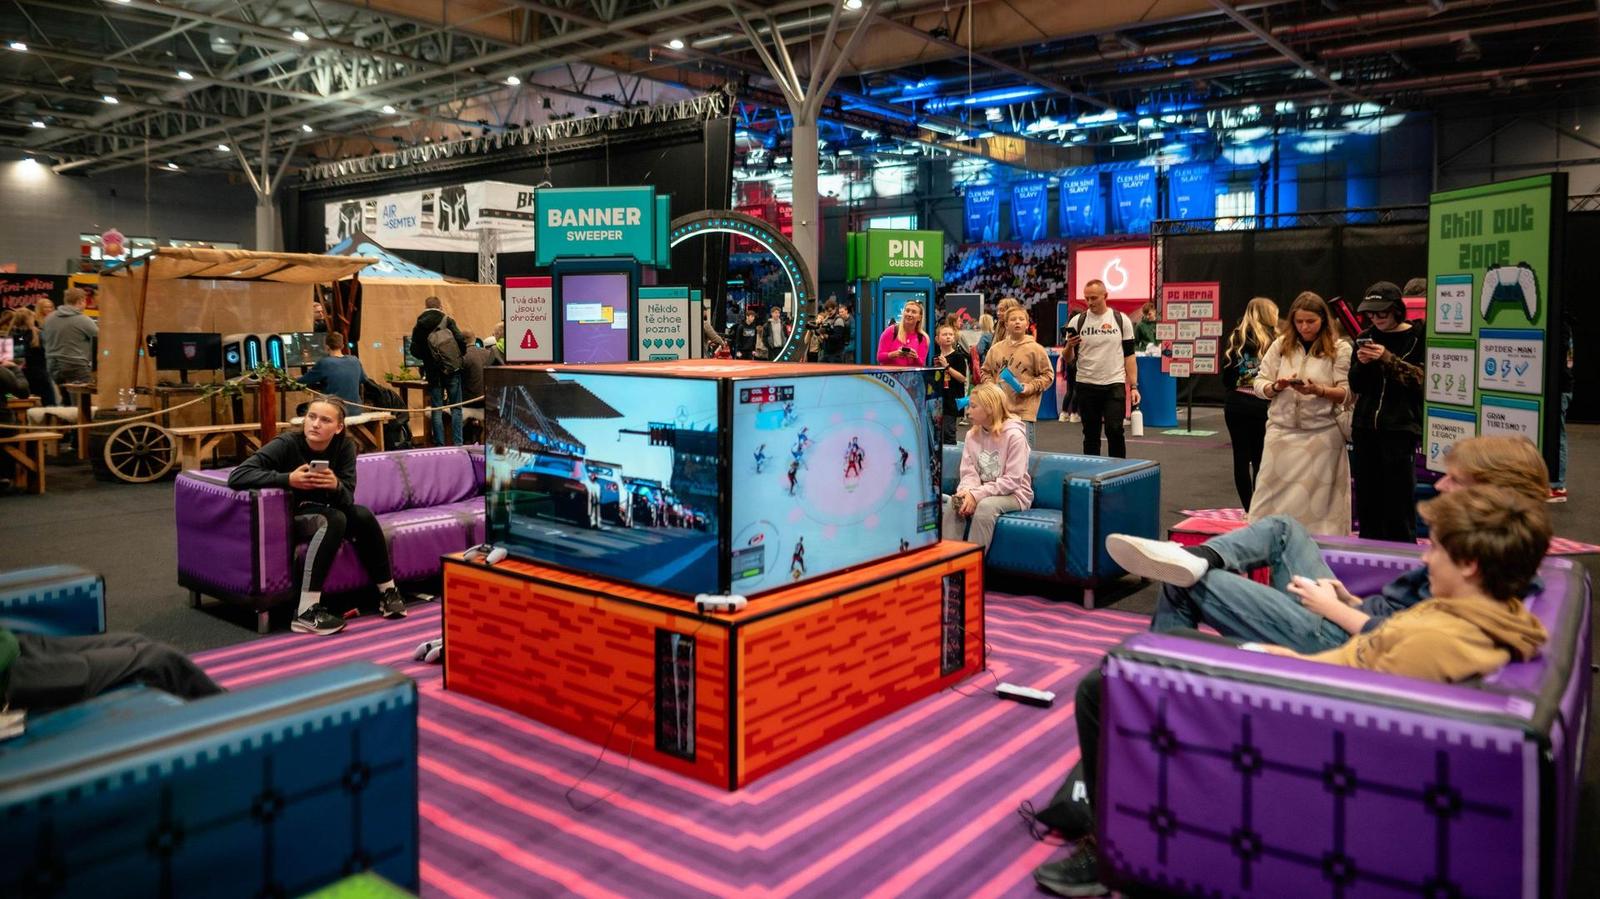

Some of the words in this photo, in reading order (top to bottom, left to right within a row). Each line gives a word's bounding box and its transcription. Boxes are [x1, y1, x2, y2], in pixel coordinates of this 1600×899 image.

[383, 204, 396, 217] AIR
[388, 215, 416, 229] SEMTEX
[547, 207, 641, 227] BANNER
[1441, 210, 1483, 240] Chill
[1493, 204, 1534, 235] out
[566, 230, 623, 241] SWEEPER
[889, 239, 924, 259] PIN
[1459, 240, 1510, 270] zone
[889, 259, 924, 268] GUESSER
[1168, 291, 1179, 299] PC
[1456, 290, 1466, 298] 25
[515, 306, 533, 314] jsou
[647, 304, 679, 314] Někdo
[510, 313, 547, 322] ohrožení
[645, 315, 655, 324] tě
[657, 316, 682, 324] chce
[645, 326, 681, 336] poznat
[1081, 327, 1118, 336] ellesse
[1486, 412, 1506, 421] GRAN
[1431, 423, 1465, 434] HOGWARTS
[1487, 421, 1520, 431] TURISMO
[1431, 431, 1457, 440] LEGACY
